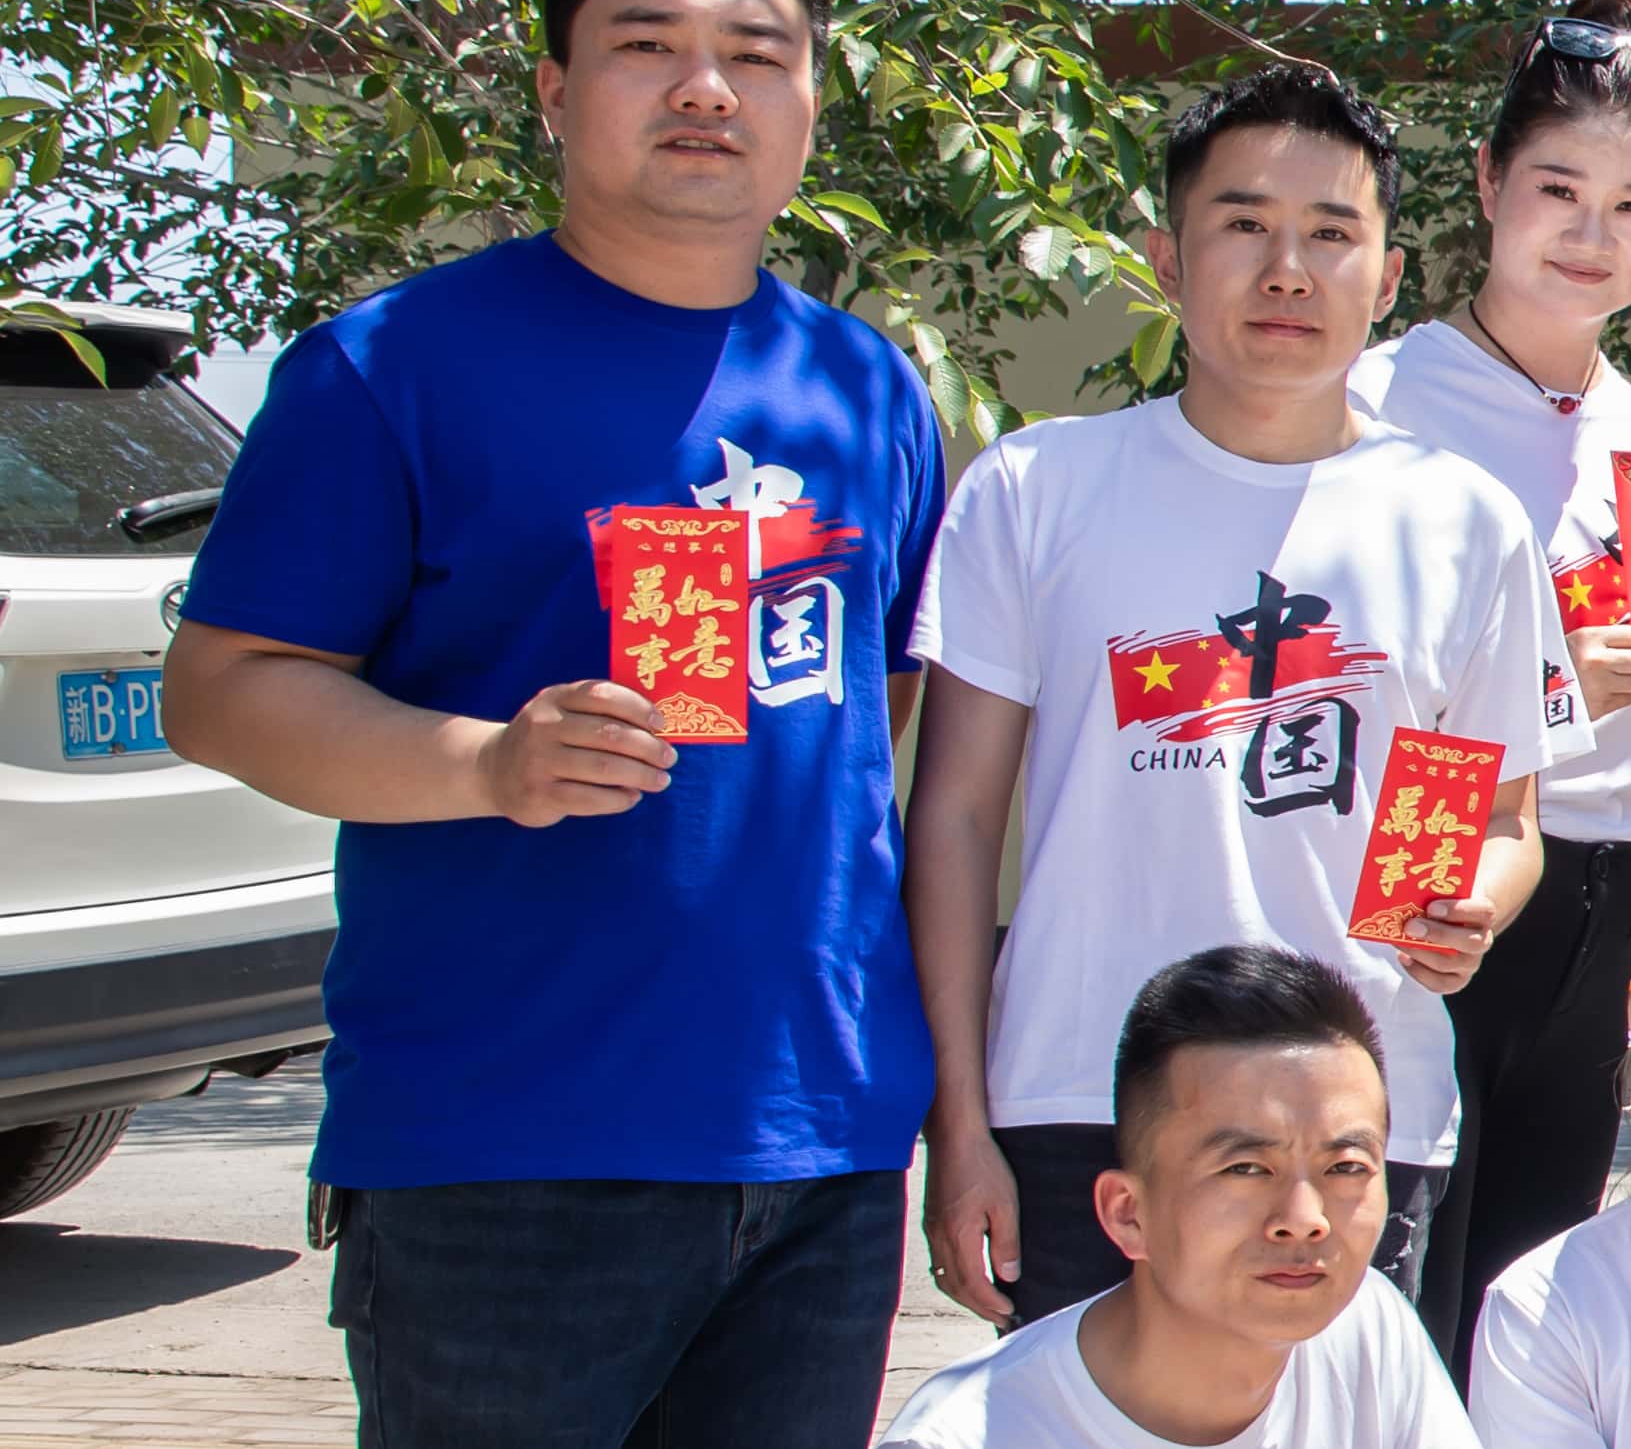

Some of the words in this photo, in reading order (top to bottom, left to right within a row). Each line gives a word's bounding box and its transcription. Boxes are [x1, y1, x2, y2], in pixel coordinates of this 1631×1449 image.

[689, 436, 845, 707] 中国
[1215, 571, 1361, 818] 中国
[1130, 747, 1228, 773] CHINA
